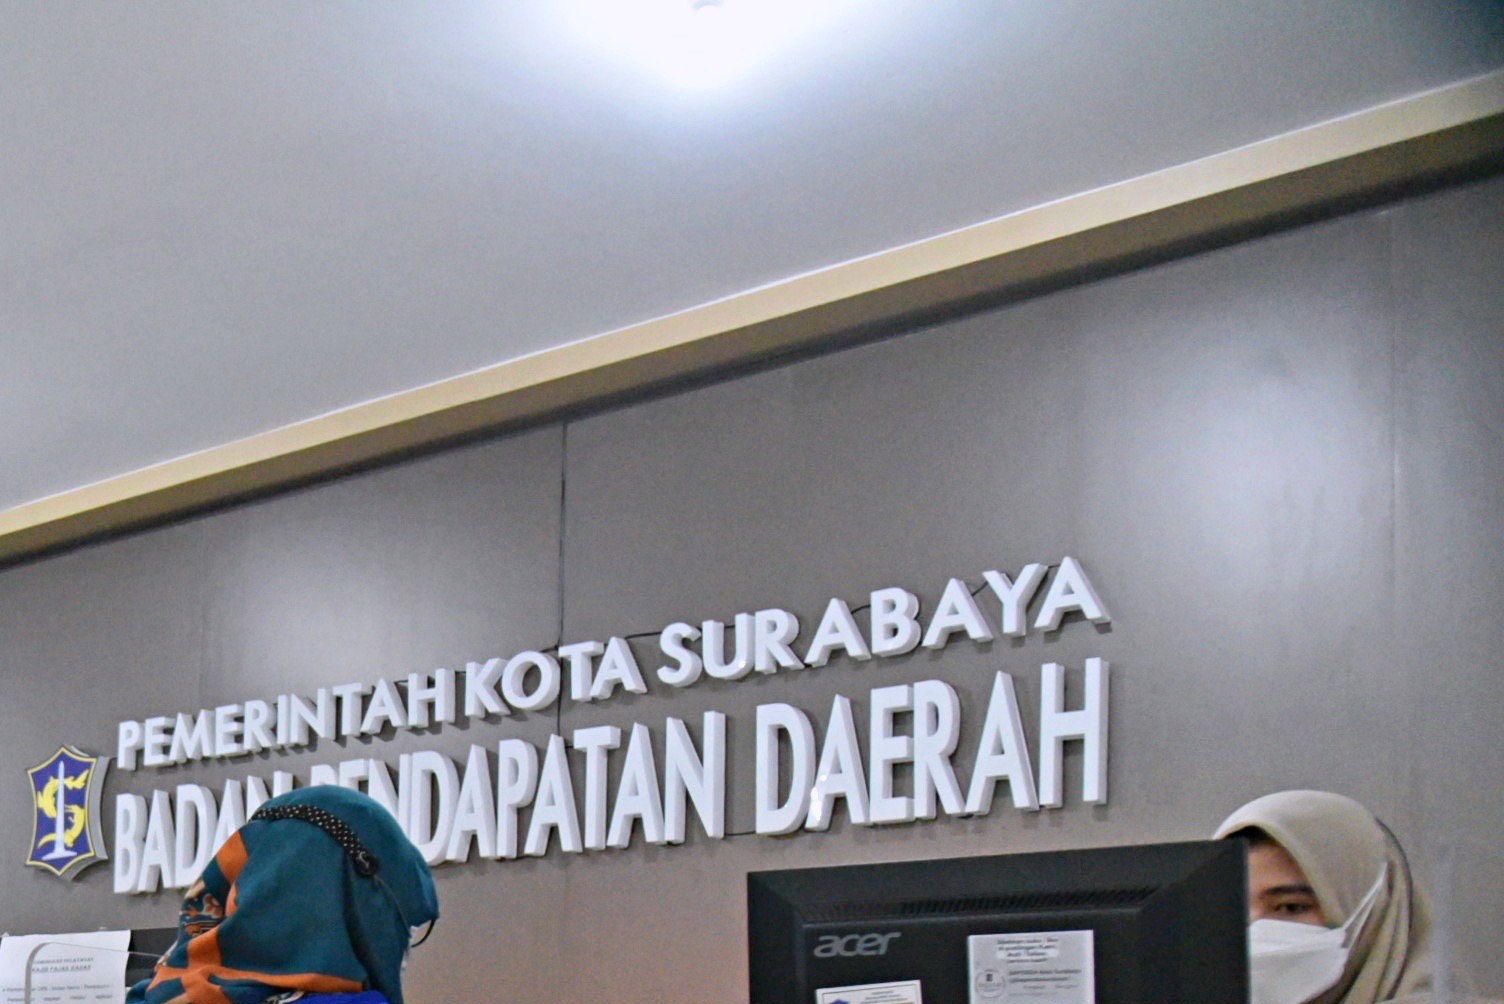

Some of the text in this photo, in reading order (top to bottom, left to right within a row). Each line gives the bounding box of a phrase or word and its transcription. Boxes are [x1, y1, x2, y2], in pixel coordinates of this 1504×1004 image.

[117, 556, 1109, 771] PEMERINTAH KOTA SURABAYA
[311, 711, 726, 866] NDAPATAN
[755, 656, 1110, 836] DAERAH
[814, 932, 902, 958] acer
